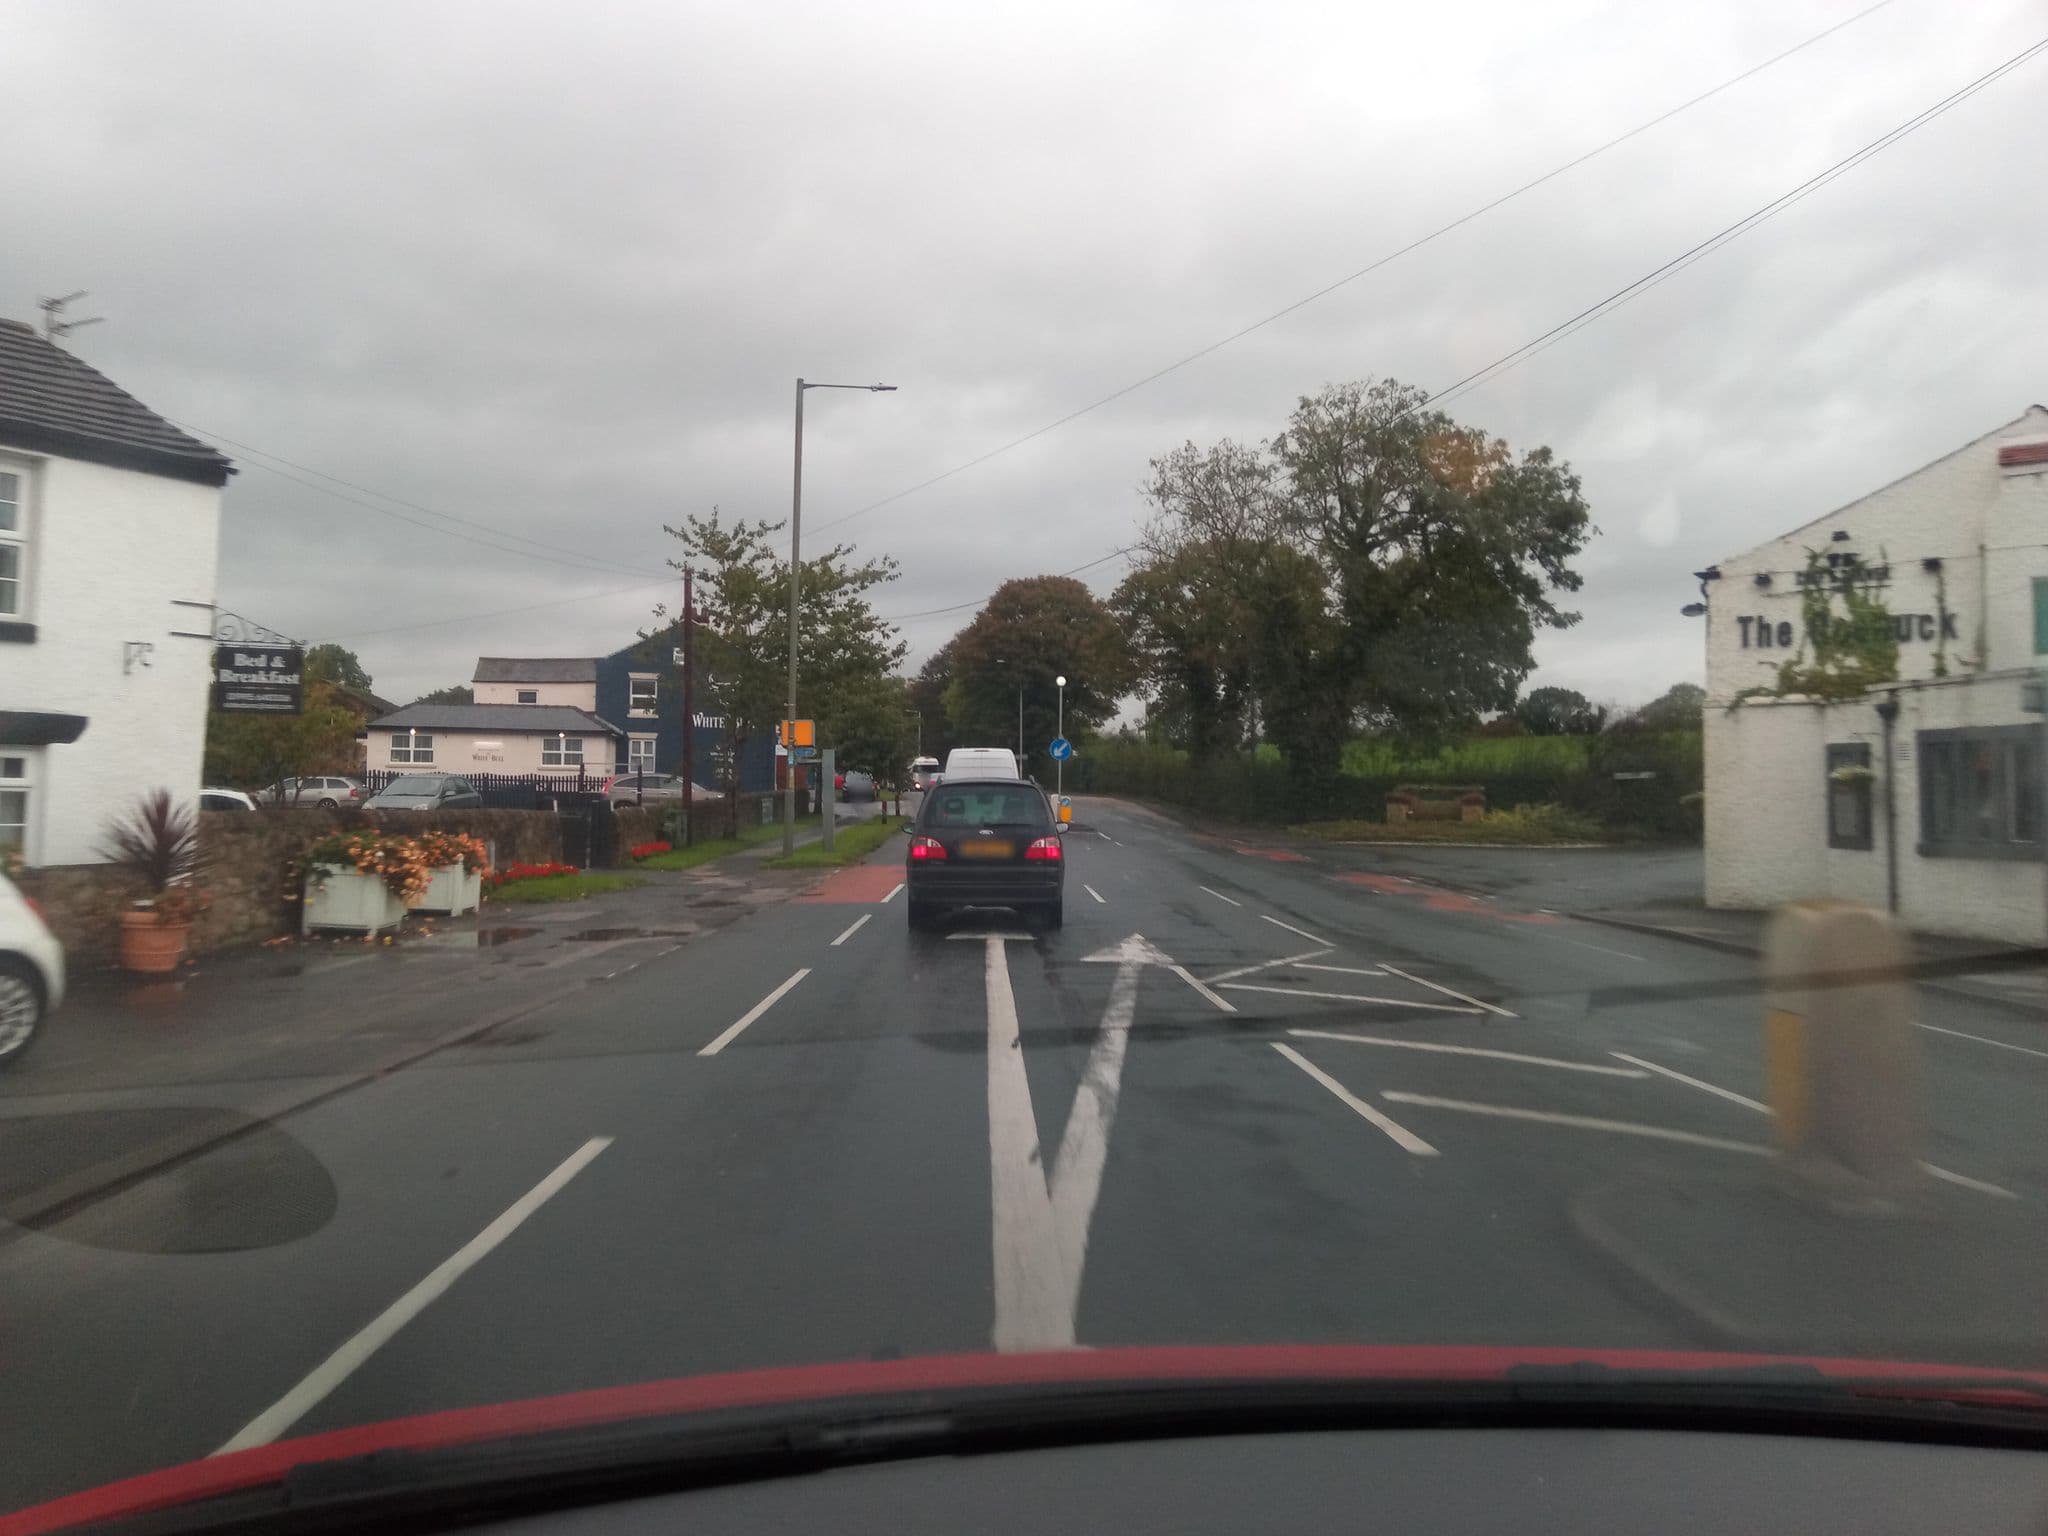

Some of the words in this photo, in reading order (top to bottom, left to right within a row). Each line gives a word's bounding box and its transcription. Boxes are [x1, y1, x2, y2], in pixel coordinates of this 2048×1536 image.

[1737, 615, 1793, 649] The
[234, 653, 267, 667] Bed
[270, 655, 286, 668] &
[219, 669, 300, 685] Breakfast
